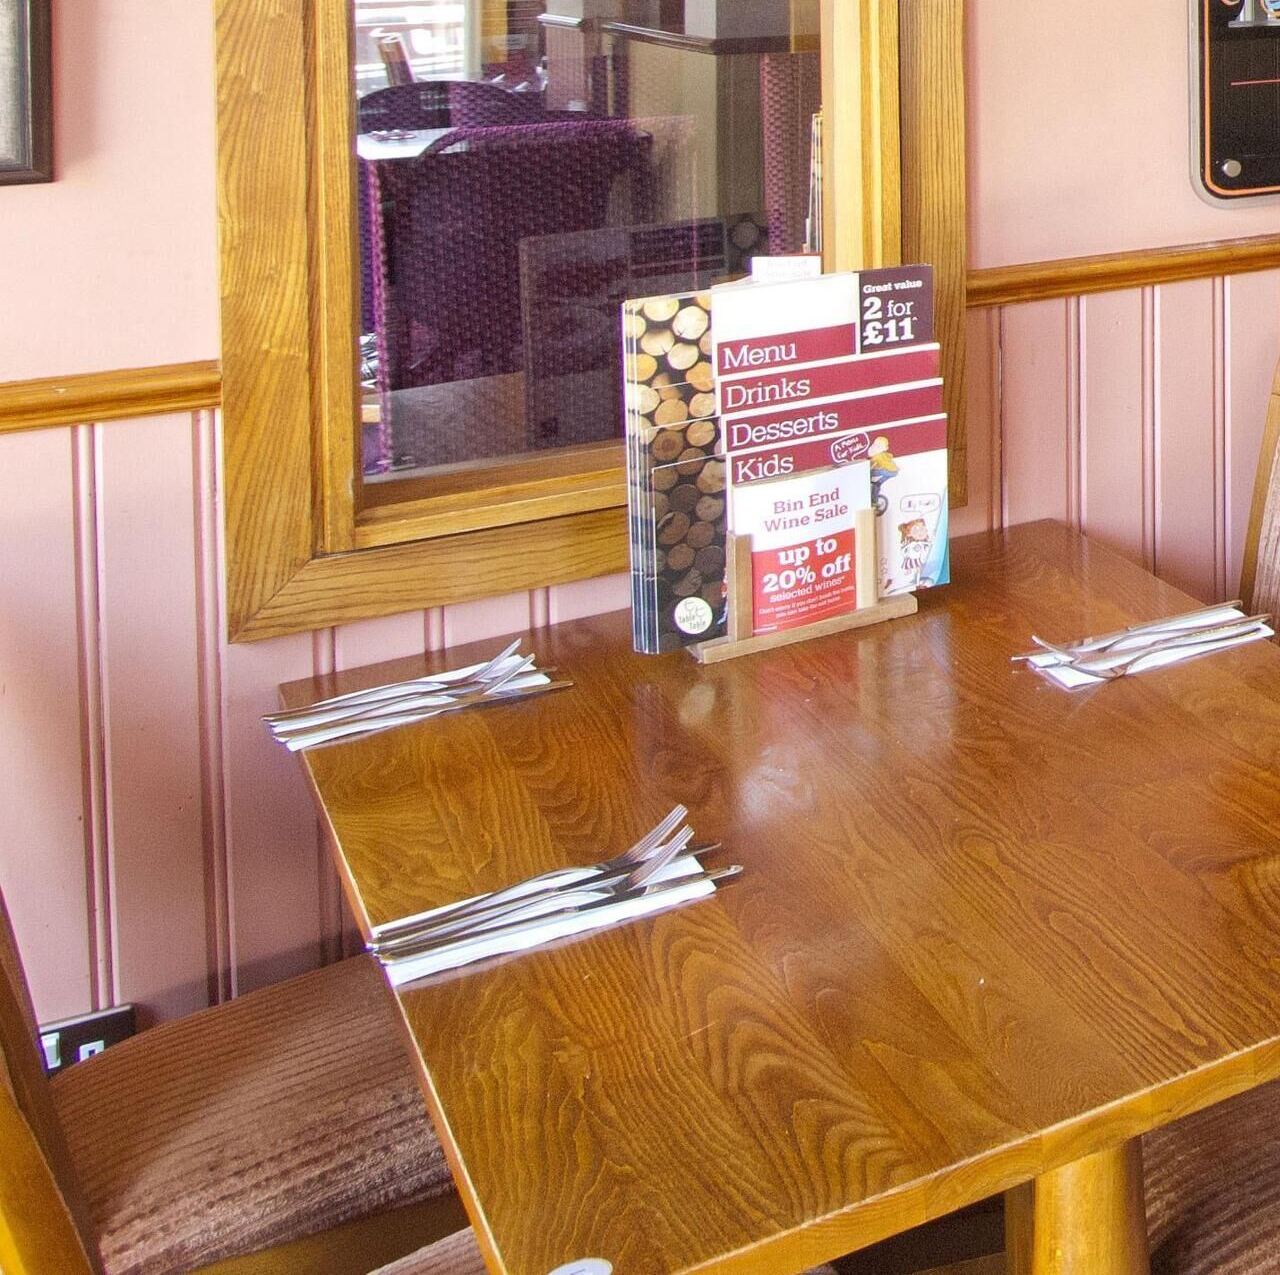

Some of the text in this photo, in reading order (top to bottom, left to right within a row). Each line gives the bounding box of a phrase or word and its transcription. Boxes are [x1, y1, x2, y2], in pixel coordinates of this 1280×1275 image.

[863, 280, 922, 293] Great value
[863, 296, 914, 320] 2 for
[723, 343, 797, 369] Menu
[726, 378, 810, 408] Drinks
[731, 411, 838, 447] Desserts
[736, 454, 794, 482] Kids
[773, 487, 840, 514] Bin End
[764, 504, 848, 532] Wine Sale
[778, 537, 837, 566] up to
[763, 553, 851, 593] 20% off
[769, 584, 812, 603] selected
